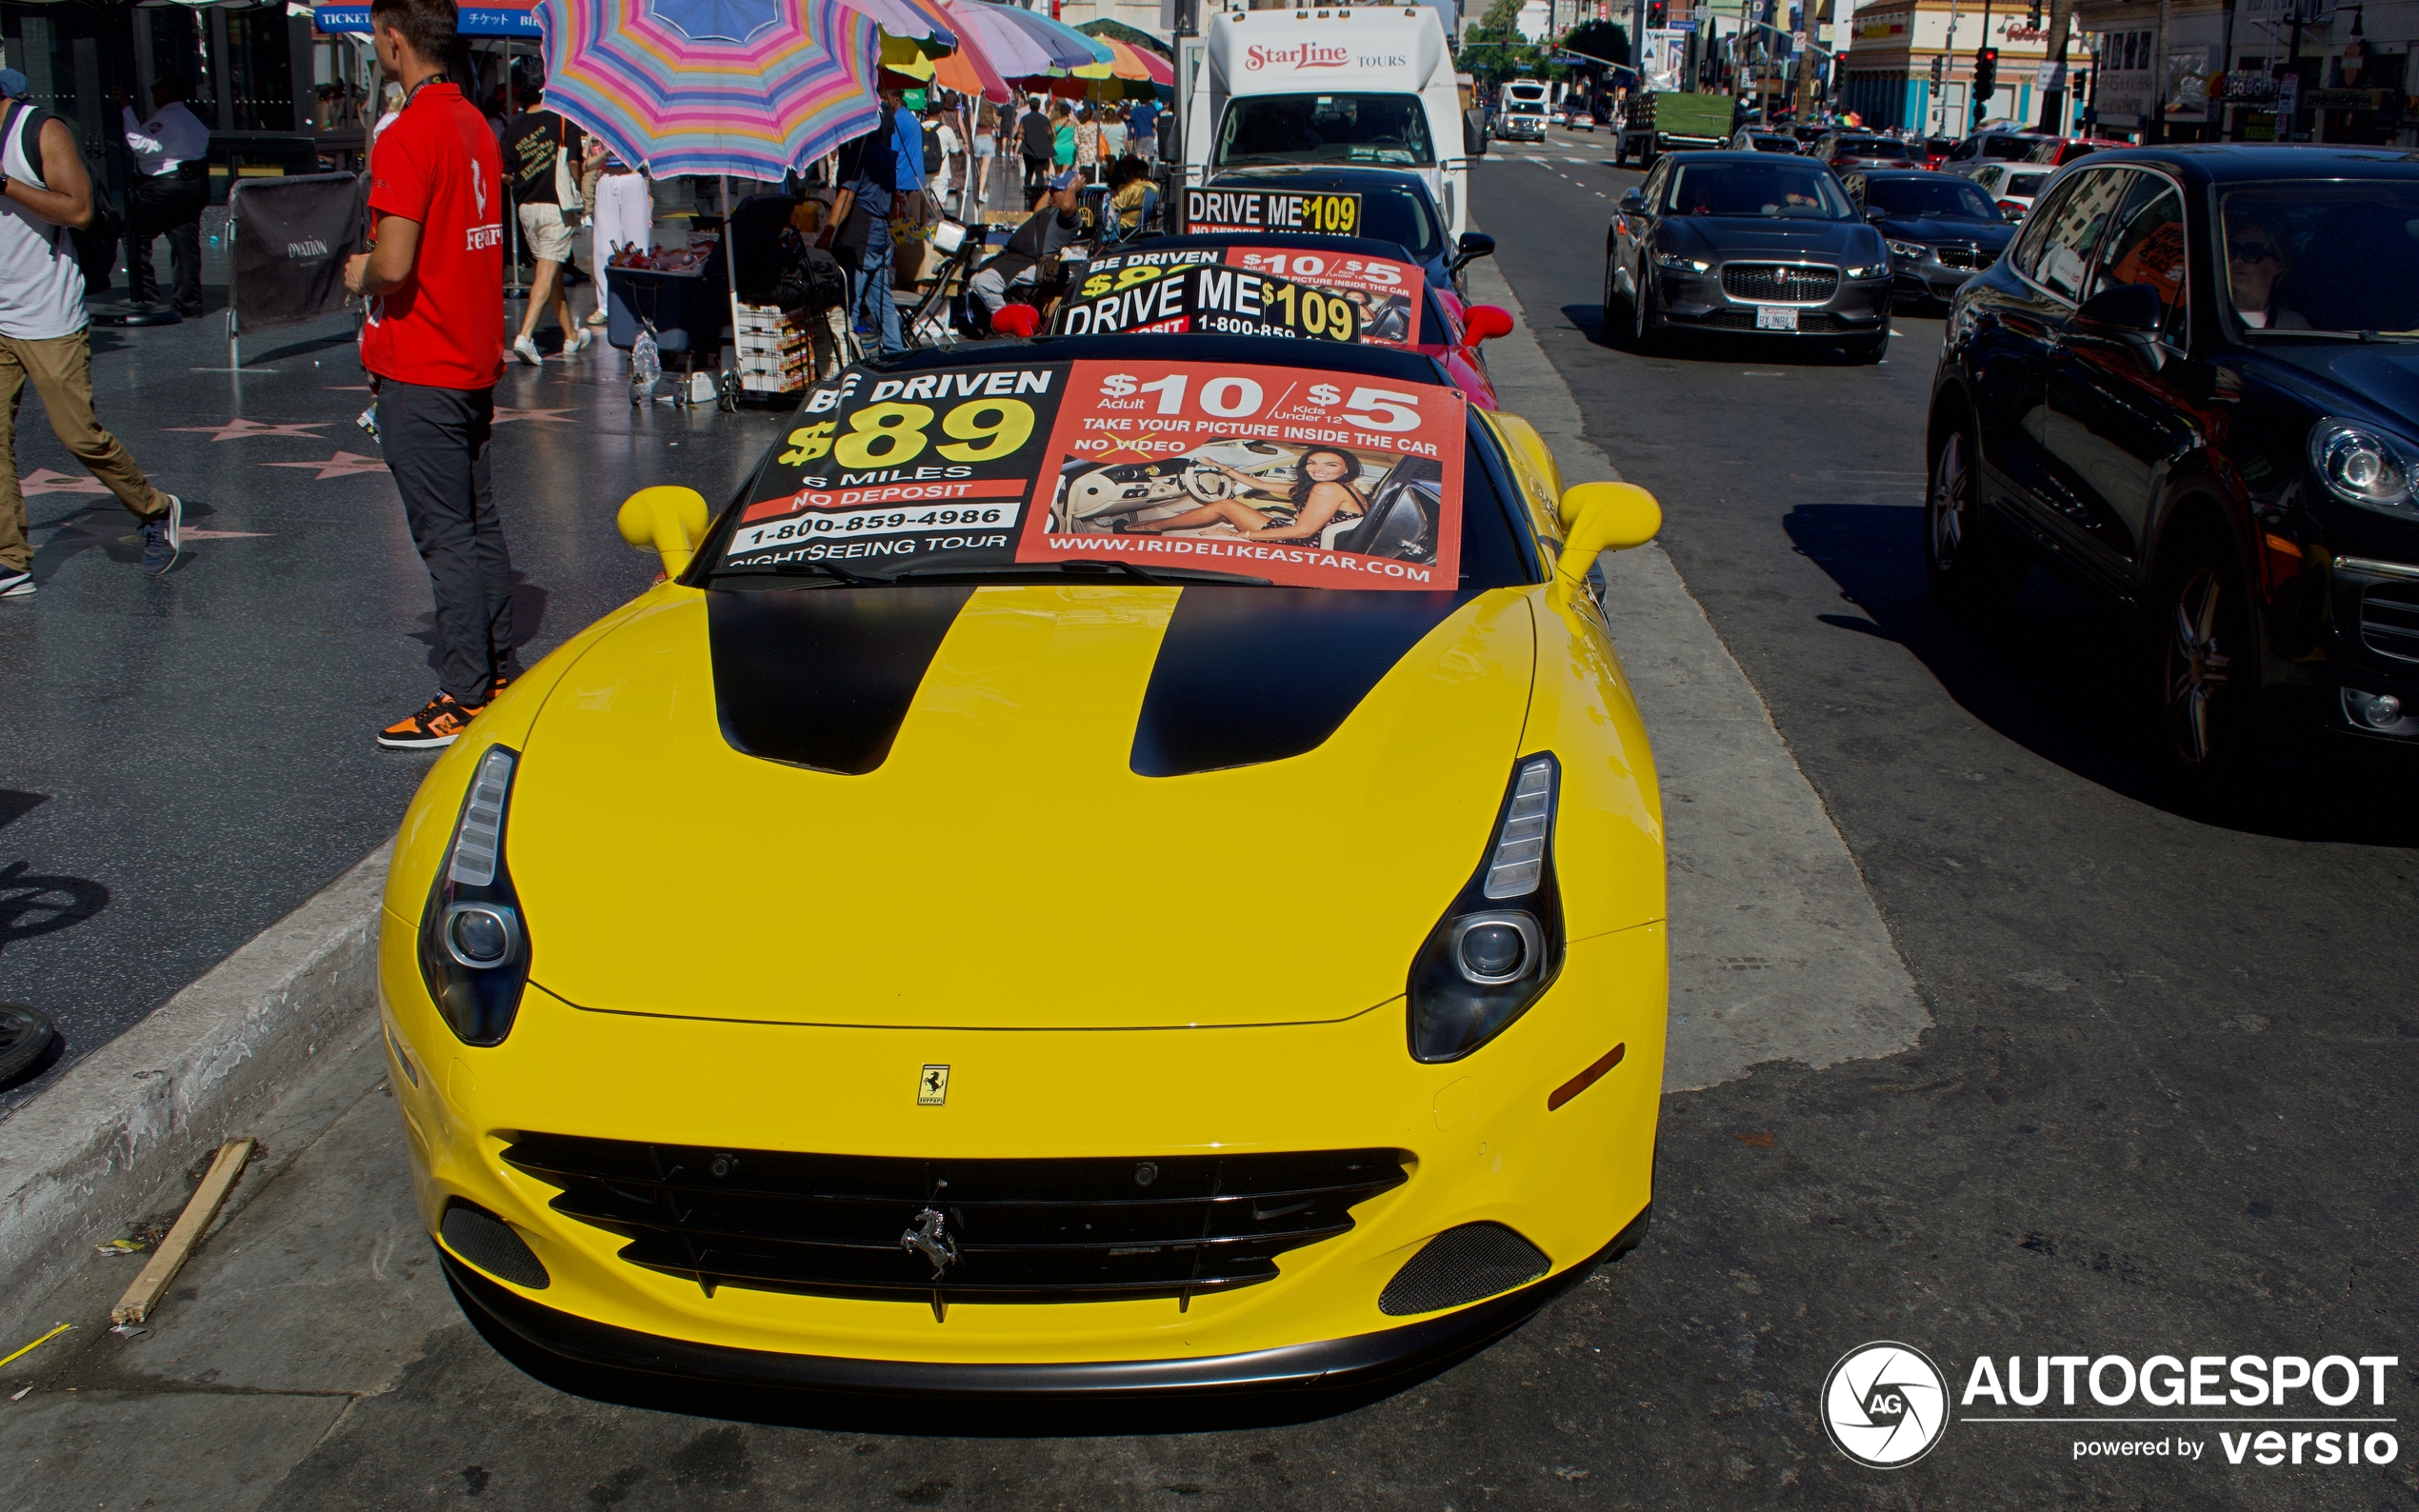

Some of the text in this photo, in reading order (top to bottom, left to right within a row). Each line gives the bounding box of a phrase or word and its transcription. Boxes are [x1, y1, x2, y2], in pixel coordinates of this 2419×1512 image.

[469, 13, 509, 26] チケット
[1245, 41, 1406, 71] StarLine TOURS
[1190, 192, 1355, 230] DRIVE ME $109
[289, 239, 328, 258] OVATION
[1090, 251, 1218, 273] BE DRIVEN
[1081, 264, 1195, 297] $8
[1243, 253, 1402, 285] $10 $5
[1291, 276, 1332, 287] PICTURE
[1335, 279, 1367, 289] INSIDE
[1369, 284, 1389, 292] THE
[1389, 288, 1409, 297] CAR
[1065, 268, 1353, 342] DRIVE ME $109
[805, 370, 1052, 413] BE DRIVEN
[1097, 397, 1146, 409] Adult
[1099, 374, 1421, 432] $10 $5
[1274, 410, 1342, 425] Under 12
[1292, 405, 1327, 415] Kids
[777, 398, 1036, 468] $89
[1074, 439, 1186, 453] NO VIDEO
[1083, 418, 1438, 456] TAKE YOUR PICTURE INSIDE THE CAR
[802, 466, 973, 488] 6 MILES
[791, 484, 972, 510] NO DEPOSIT
[750, 508, 1002, 545] 1-800-859-4986
[925, 535, 1008, 551] TOUR
[1049, 537, 1430, 583] WWW.IRIDELIKEASTAR.COM
